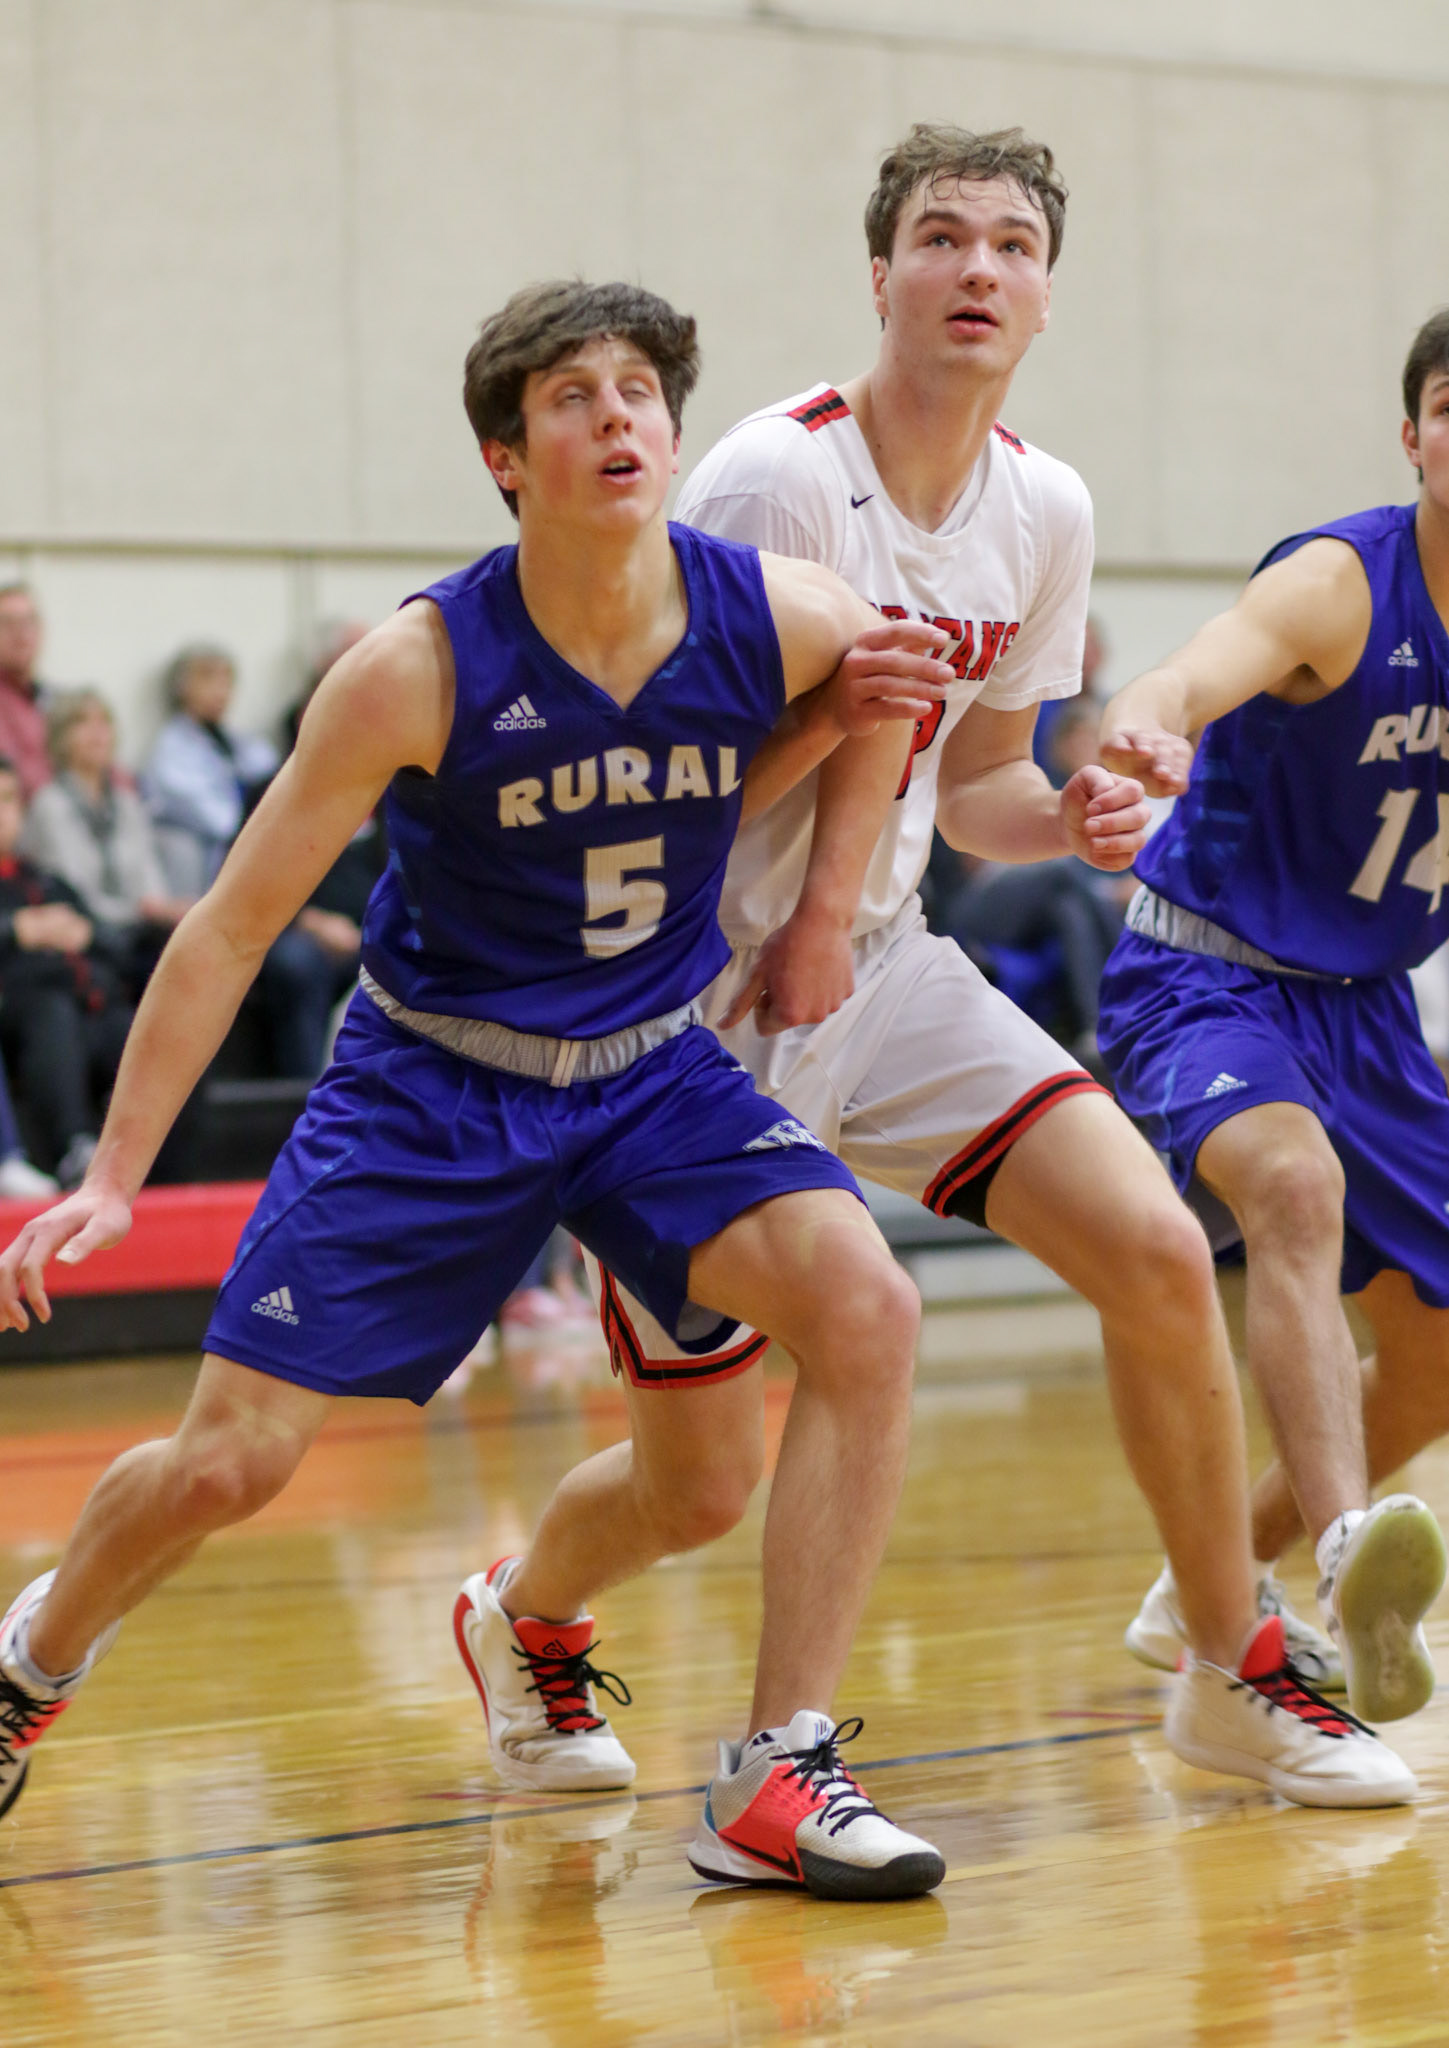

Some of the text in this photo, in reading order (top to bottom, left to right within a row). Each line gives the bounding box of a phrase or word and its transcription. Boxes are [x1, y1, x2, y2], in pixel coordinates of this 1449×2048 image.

[493, 717, 547, 731] adidas
[498, 744, 743, 829] RURAL
[579, 834, 668, 960] 5
[250, 1302, 300, 1325] adidas
